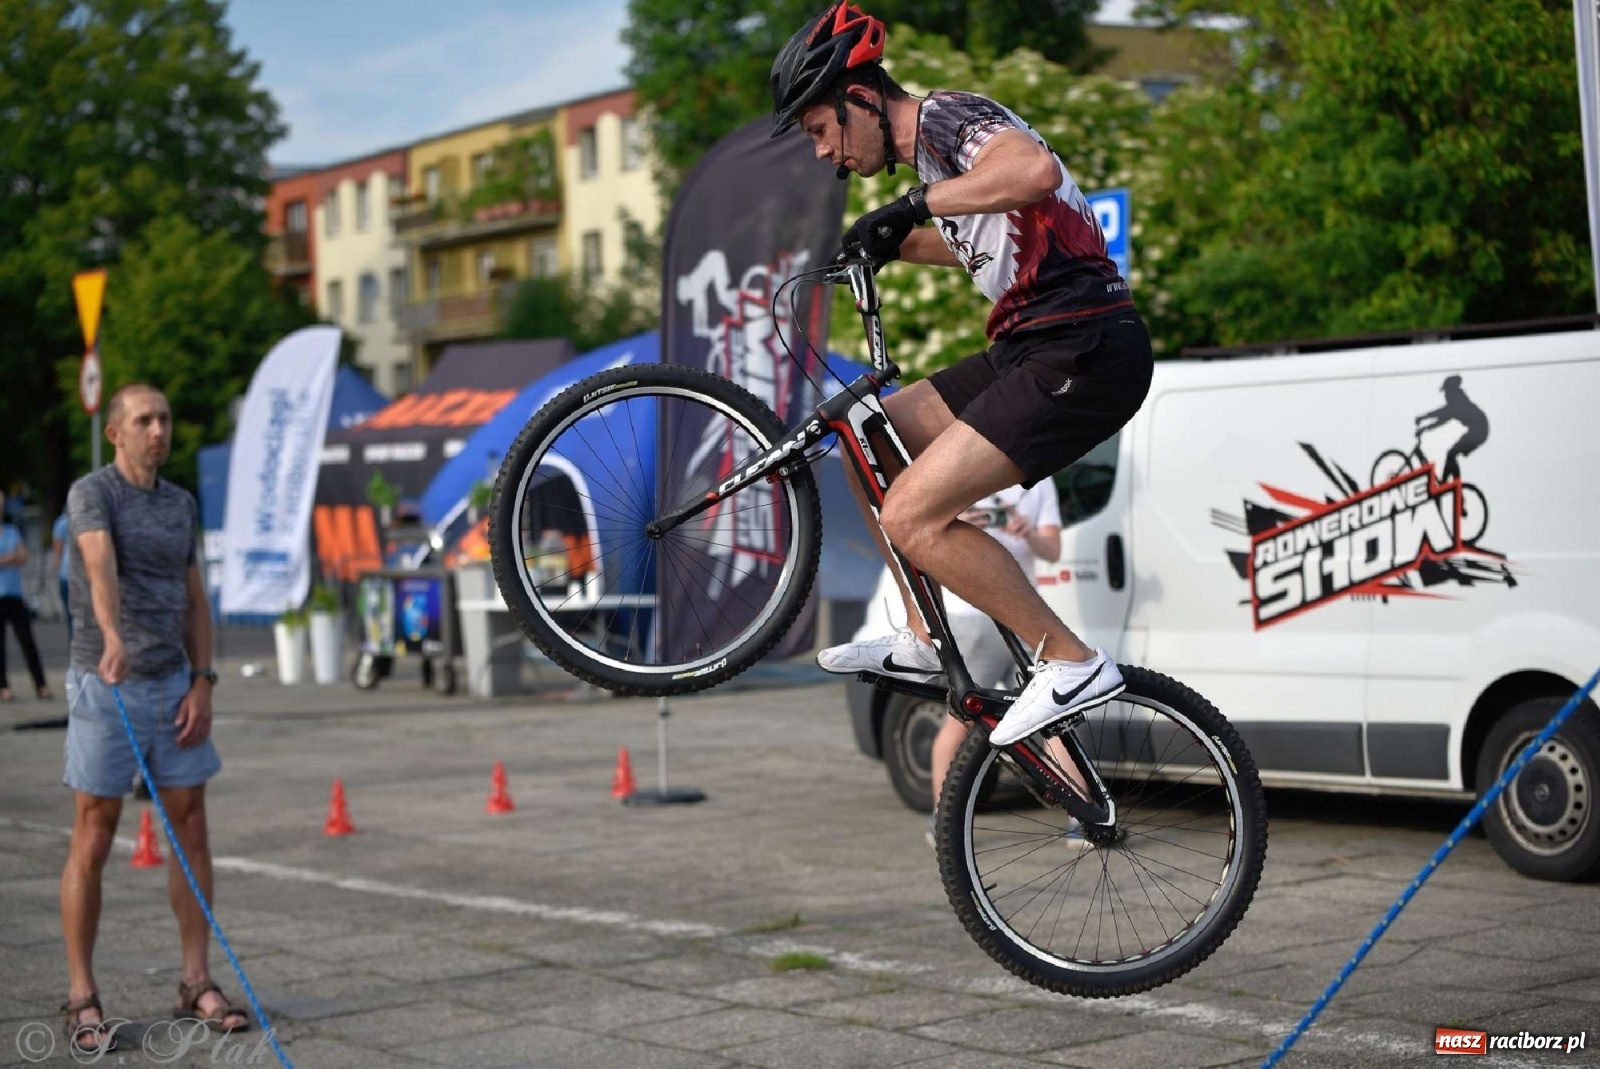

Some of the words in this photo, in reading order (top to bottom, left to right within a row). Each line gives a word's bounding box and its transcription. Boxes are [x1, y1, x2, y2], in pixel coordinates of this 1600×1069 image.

[718, 431, 805, 496] CLEAN
[1255, 474, 1429, 568] ROWEROWE
[1255, 491, 1456, 622] SHOW
